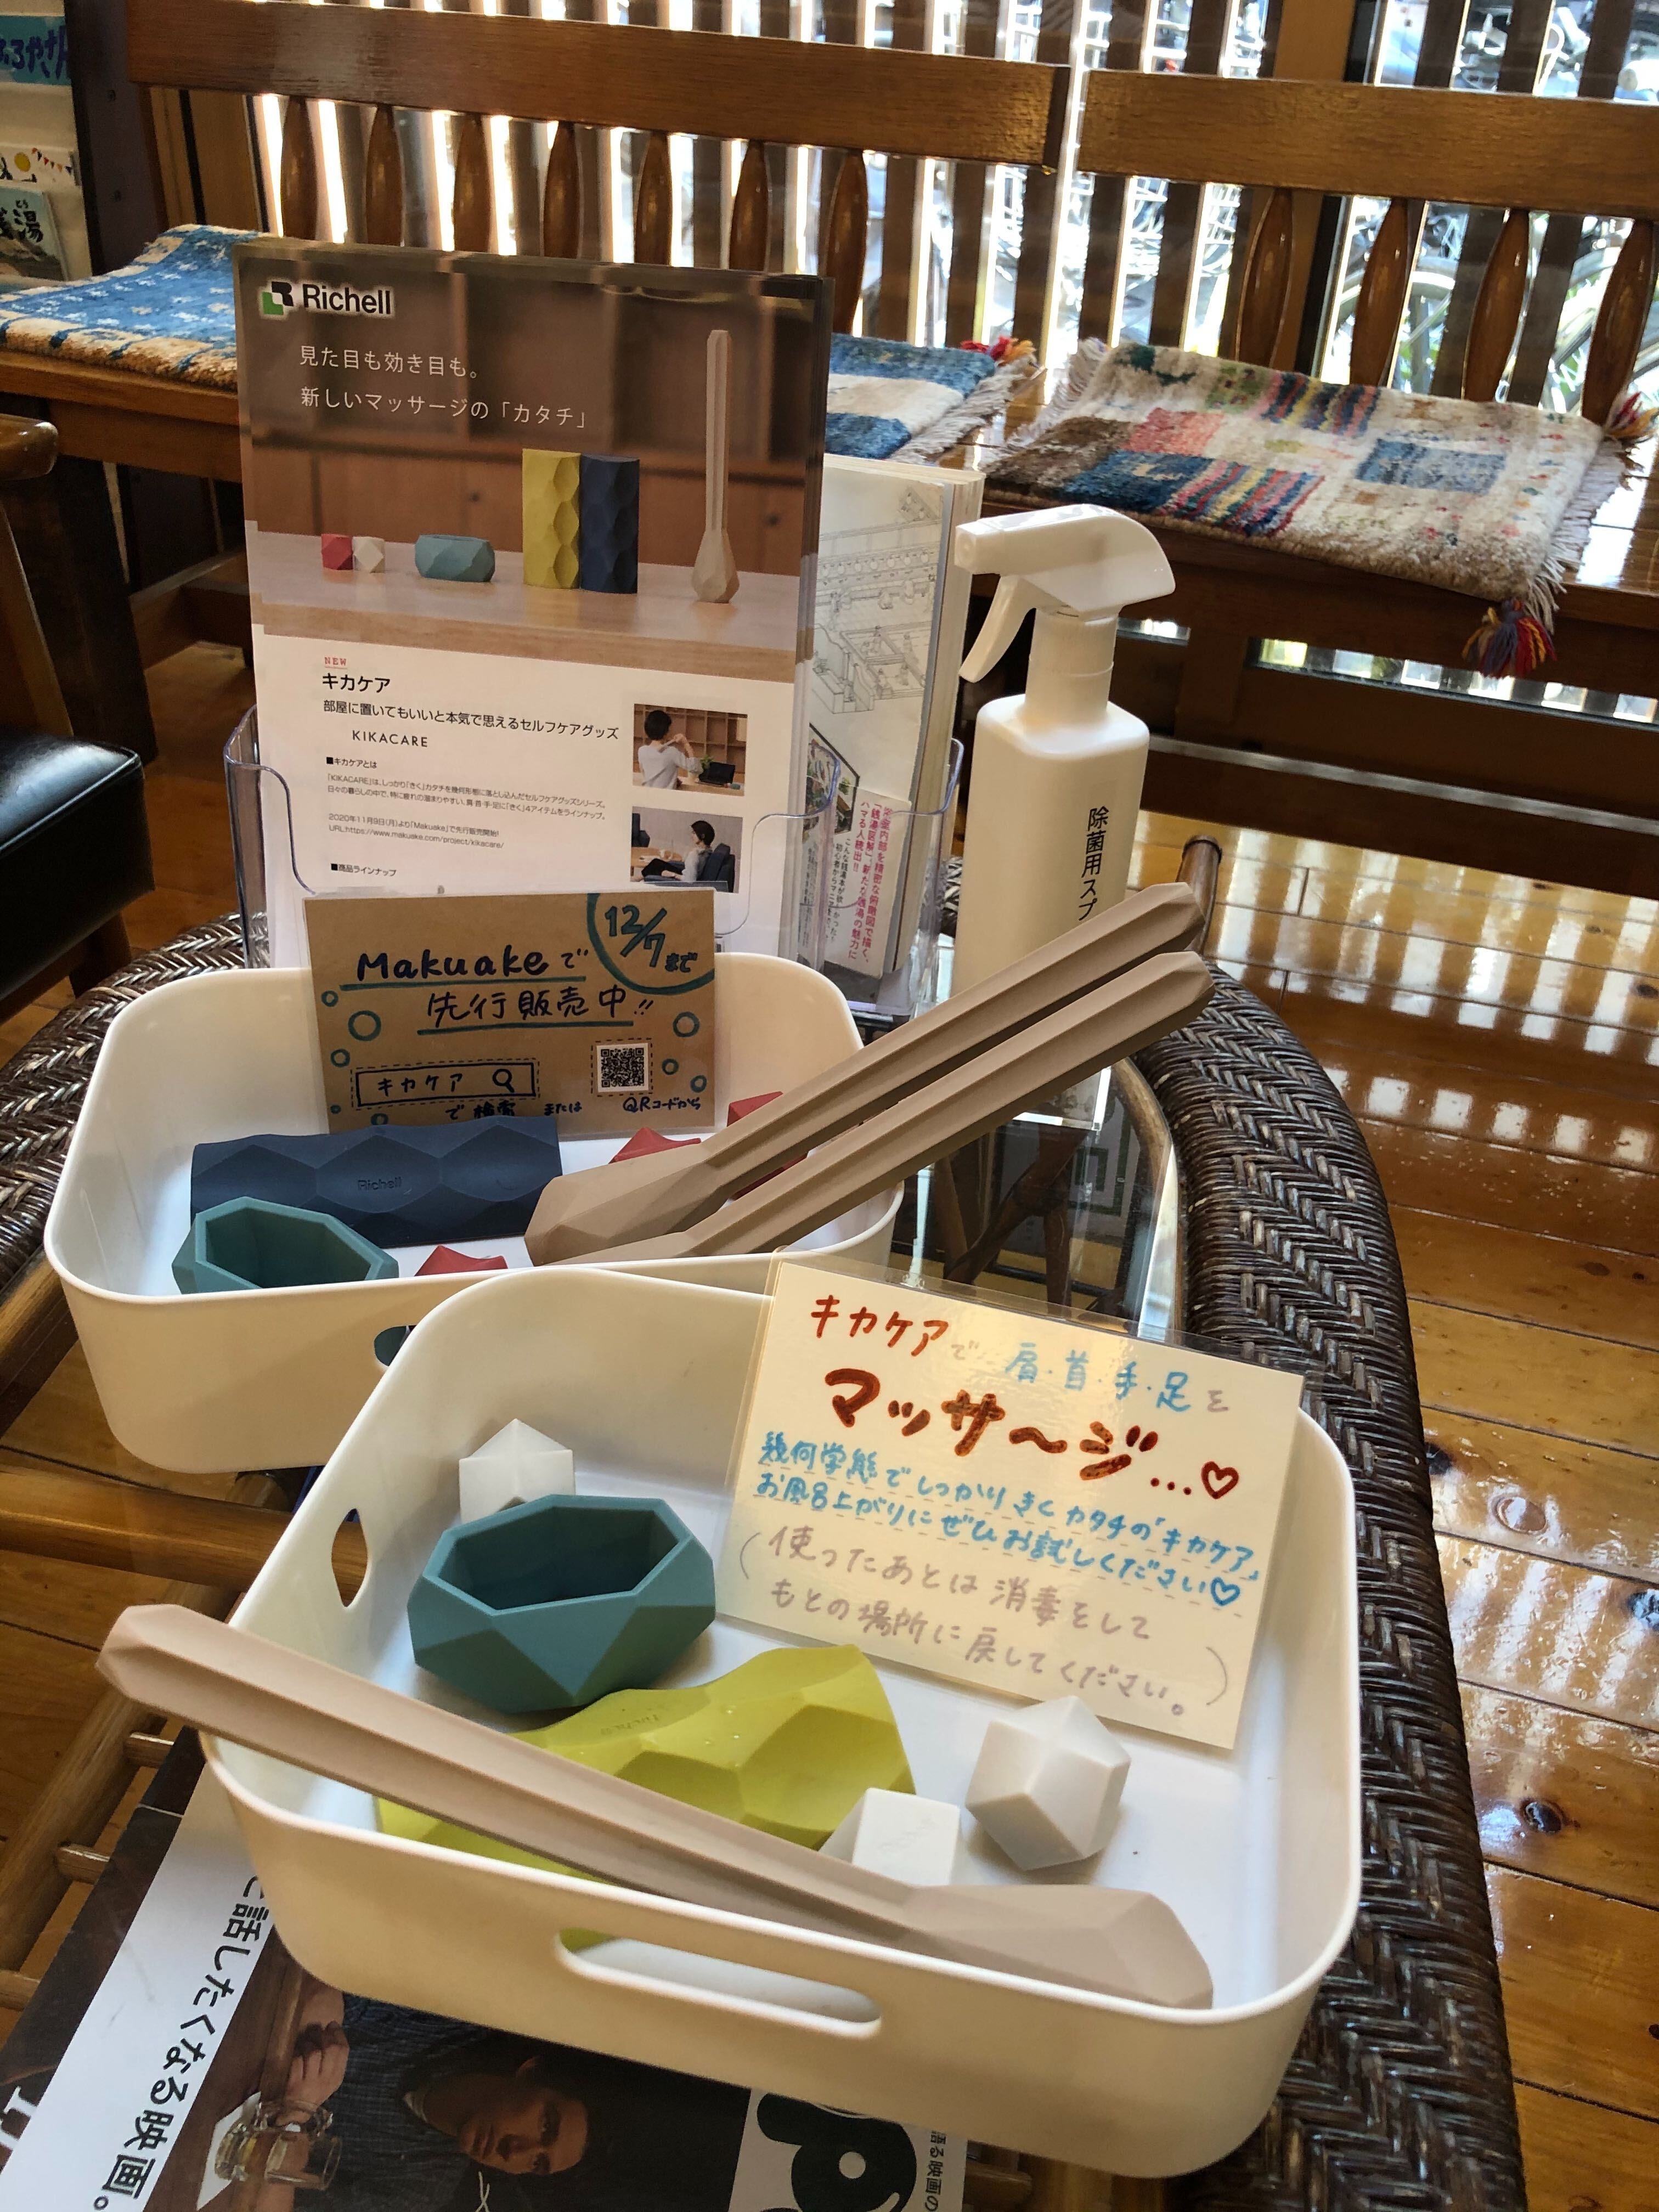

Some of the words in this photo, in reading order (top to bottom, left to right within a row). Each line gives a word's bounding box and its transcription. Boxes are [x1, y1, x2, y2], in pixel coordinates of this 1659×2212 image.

[302, 284, 391, 315] Richell
[300, 345, 477, 379] 見た目も効き目も。
[301, 386, 585, 428] 新しいマッサージの「カタチ」
[324, 657, 347, 666] NEW
[322, 672, 391, 693] キカケア
[324, 699, 619, 741] 部屋に置いてもいいと本気で思えるセルフケアグッズ
[352, 730, 428, 747] KIKACARE
[1078, 805, 1109, 921] 除菌用スプ
[427, 984, 654, 1028] 先行販売中!!
[378, 1073, 464, 1096] キカケア
[622, 1096, 702, 1113] QRコードから
